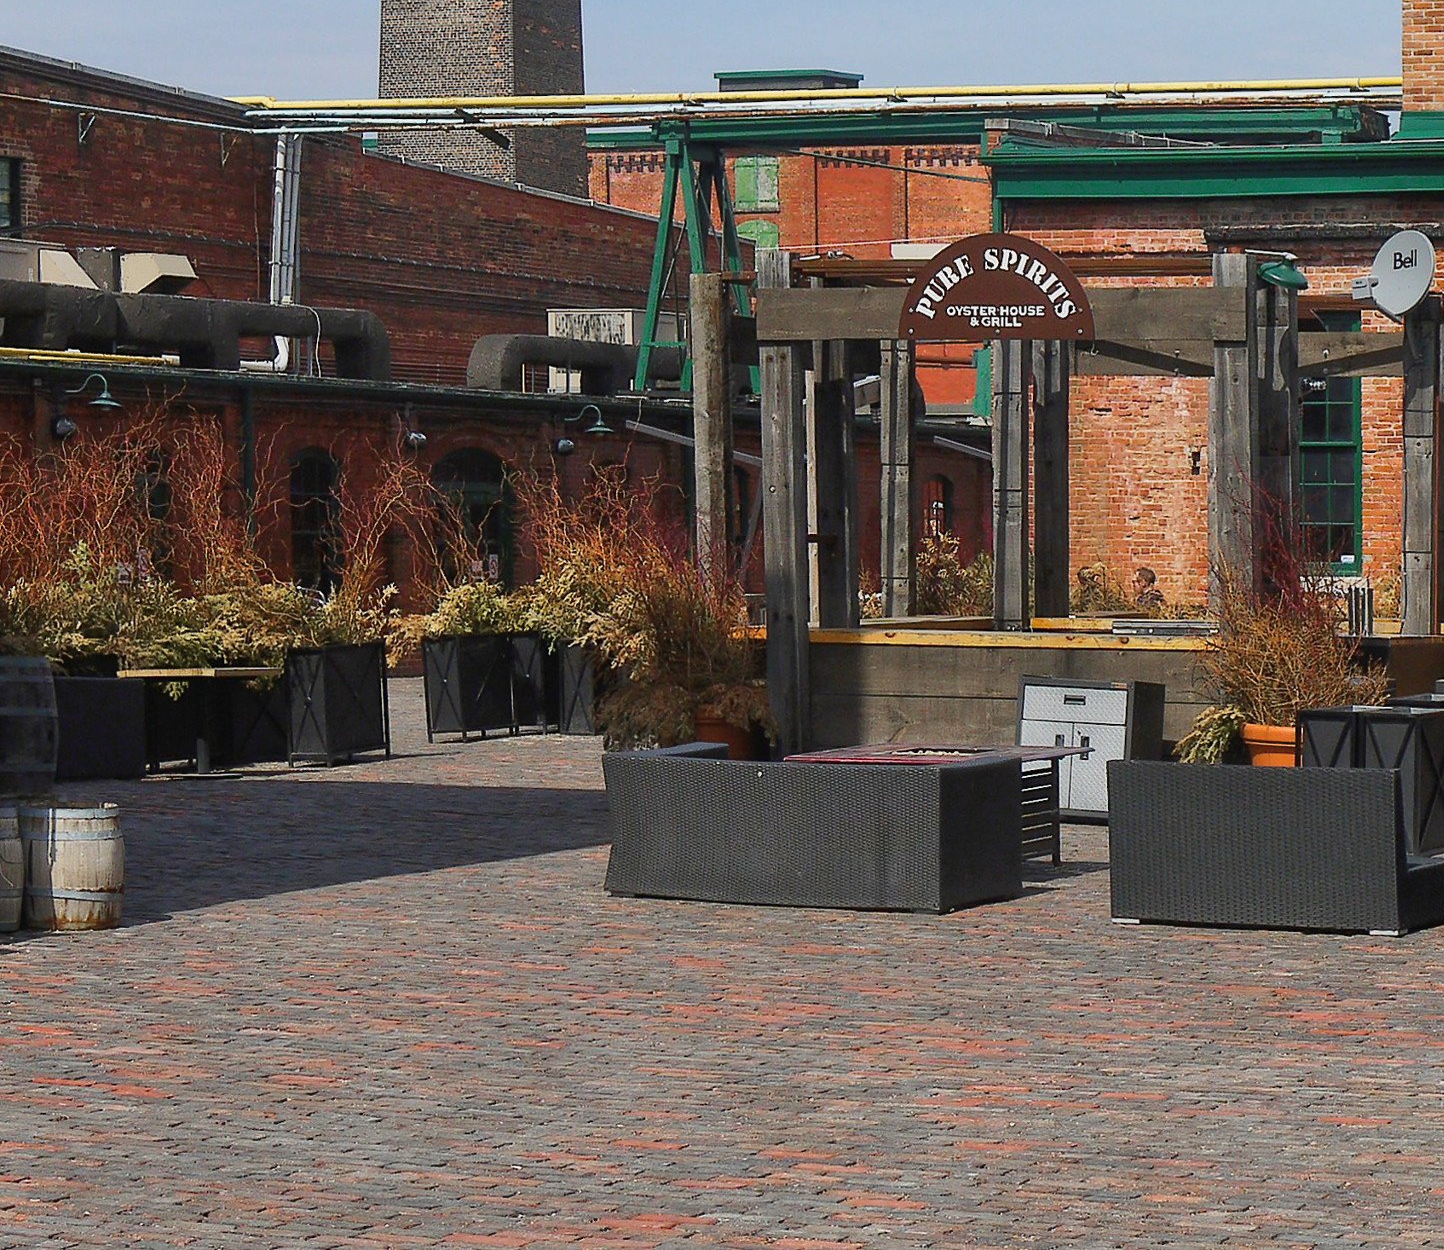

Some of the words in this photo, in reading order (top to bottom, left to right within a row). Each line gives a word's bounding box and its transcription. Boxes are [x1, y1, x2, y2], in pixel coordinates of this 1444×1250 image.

[1393, 249, 1418, 270] Bell
[915, 254, 974, 320] PURE
[984, 249, 1077, 319] SPIRITS
[946, 305, 997, 317] OYSTER
[999, 305, 1045, 317] HOUSE
[969, 317, 980, 327] &
[981, 317, 1022, 328] GRILL
